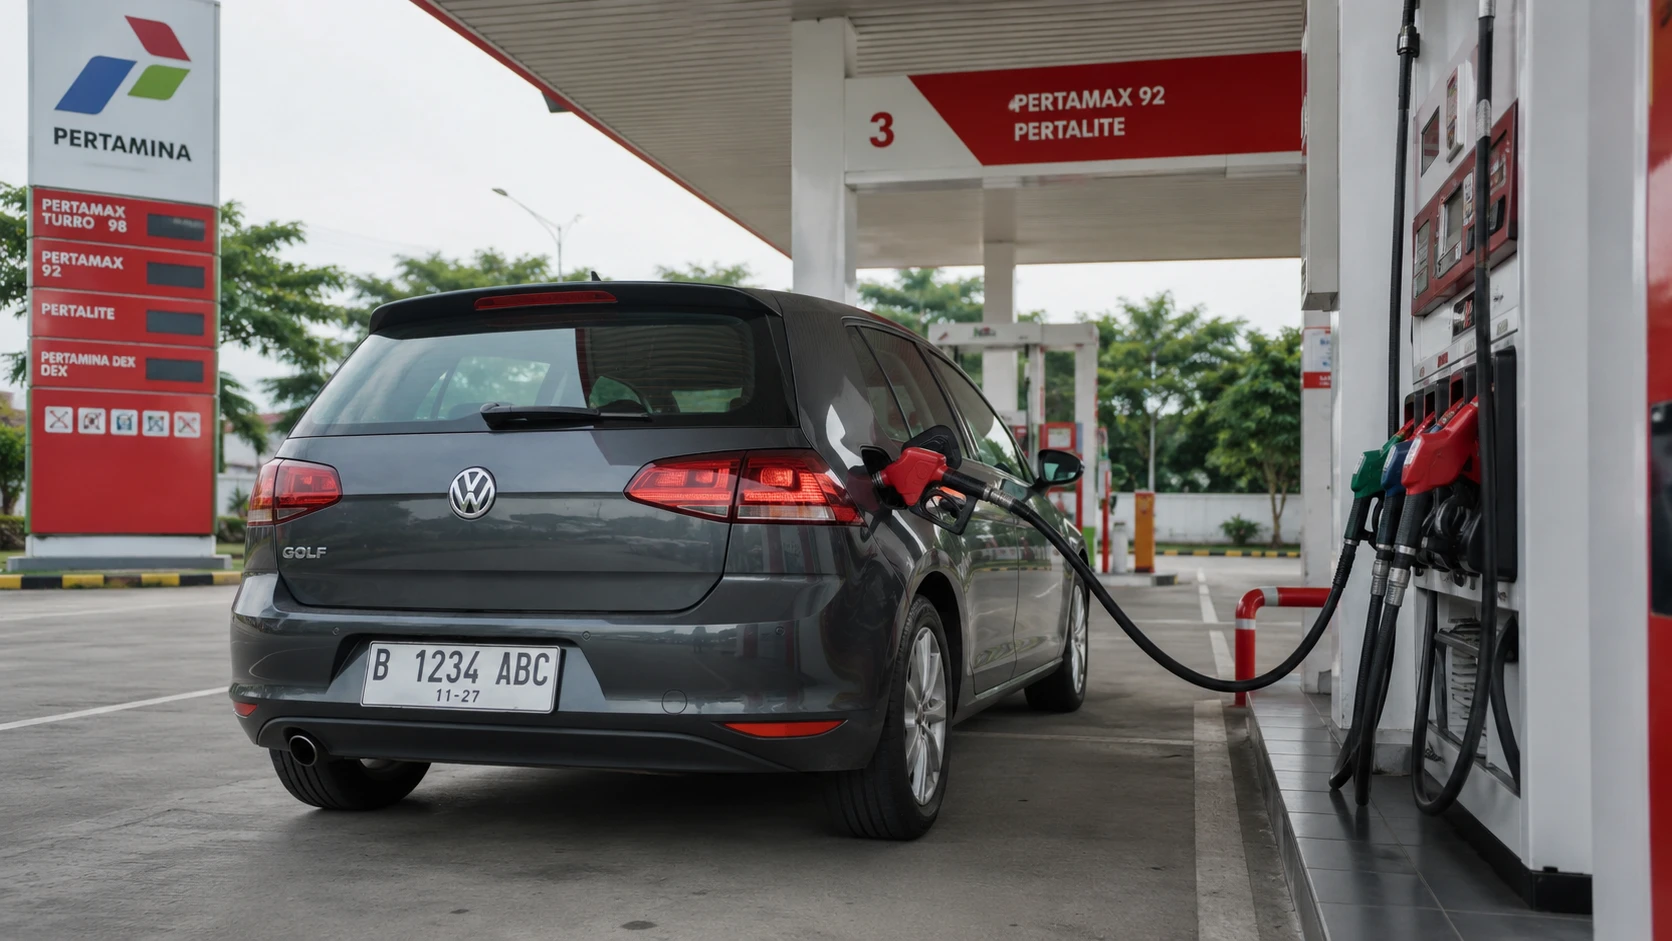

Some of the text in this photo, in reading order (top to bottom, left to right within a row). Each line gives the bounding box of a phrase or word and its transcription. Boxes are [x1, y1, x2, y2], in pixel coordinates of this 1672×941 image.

[1013, 86, 1165, 112] PERTAMAX 92
[869, 112, 895, 148] 3
[1014, 117, 1126, 141] PERTALITE
[54, 127, 192, 162] PERTAMINA
[41, 198, 125, 218] PERTAMAX
[42, 212, 128, 233] TURRO 98
[41, 251, 124, 270] PERTAMAX
[41, 264, 62, 277] 92
[41, 302, 115, 320] PERTALITE
[40, 351, 136, 368] PERTAMINA DEX
[40, 364, 68, 377] DEX
[282, 546, 327, 560] GOLF
[372, 648, 550, 686] B 1234 ABC
[435, 688, 481, 704] 11-27
